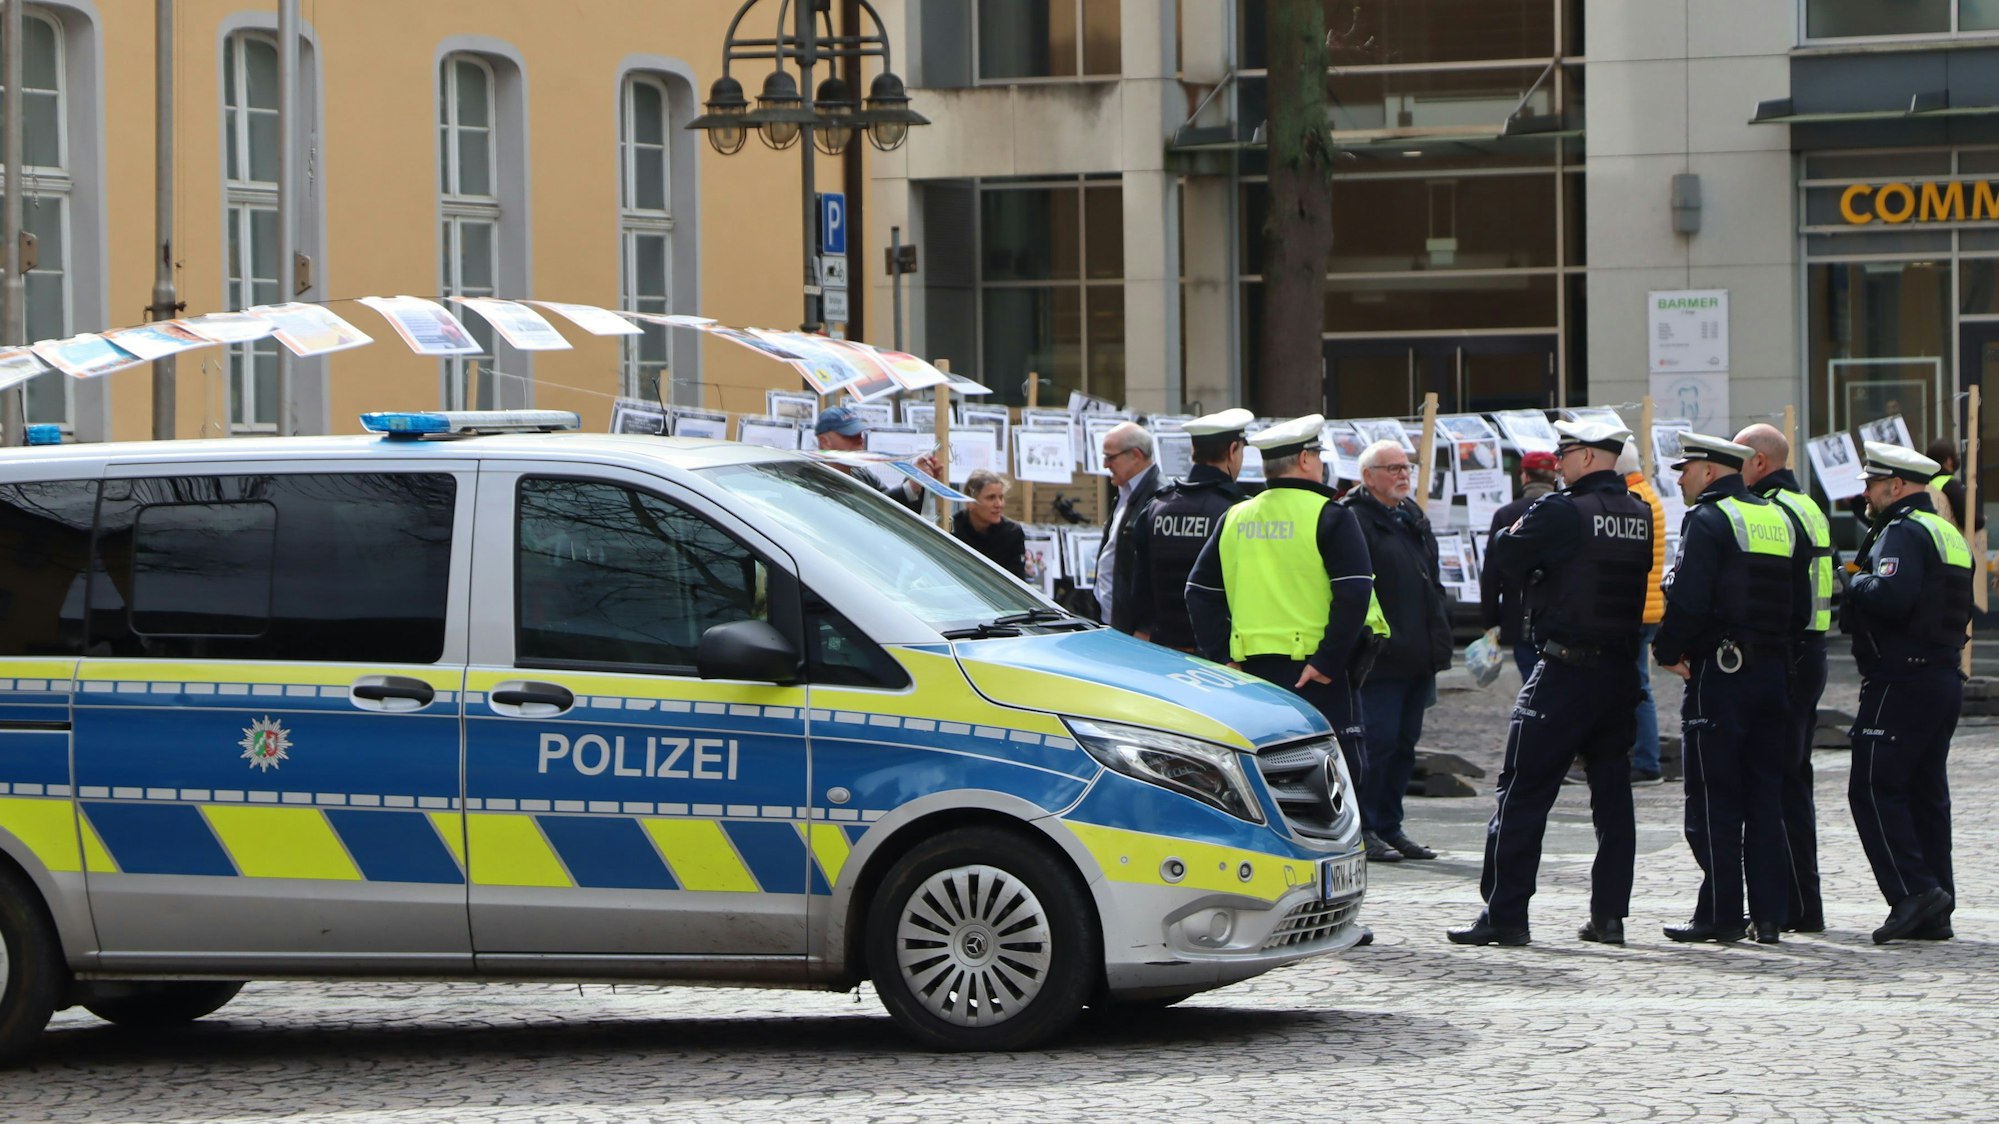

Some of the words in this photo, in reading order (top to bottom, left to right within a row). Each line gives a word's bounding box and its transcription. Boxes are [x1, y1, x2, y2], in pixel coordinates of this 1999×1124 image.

[828, 200, 841, 246] P
[1657, 297, 1719, 309] BARMER
[1154, 515, 1210, 537] POLIZEI
[1237, 520, 1294, 541] POLIZEI
[1593, 515, 1648, 540] POLIZEI
[1750, 523, 1786, 543] POLIZEI
[1862, 728, 1885, 736] POLIZEI
[538, 732, 738, 780] POLIZEI
